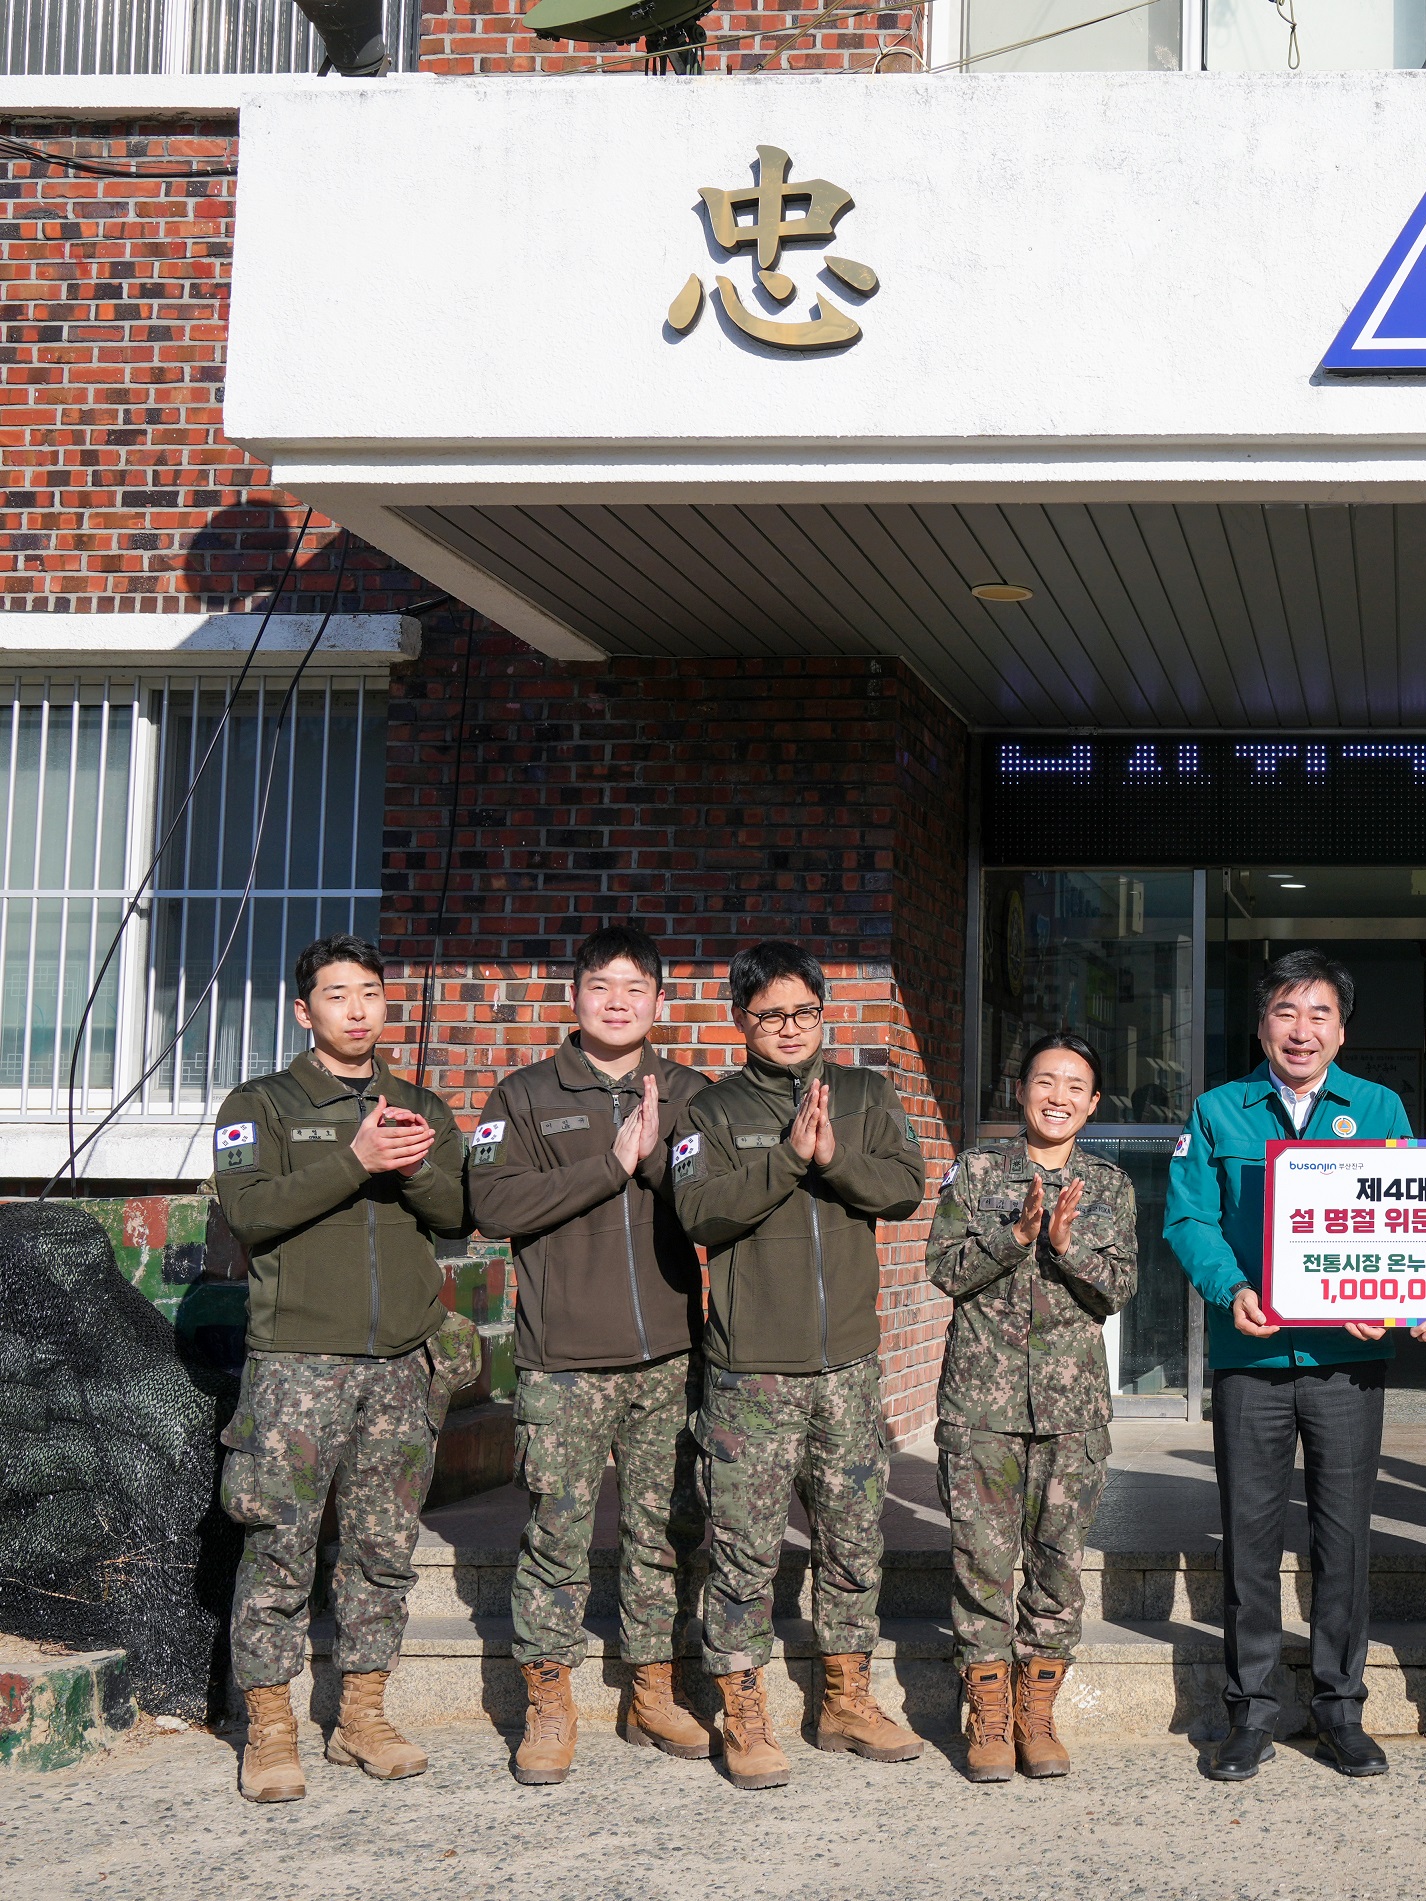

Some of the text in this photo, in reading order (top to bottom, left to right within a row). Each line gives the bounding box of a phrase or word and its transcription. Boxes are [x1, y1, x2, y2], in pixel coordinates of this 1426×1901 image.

[668, 144, 880, 351] 忠
[1290, 1161, 1364, 1172] busanjin 부산진구
[1289, 1208, 1314, 1234] 설
[1324, 1208, 1375, 1234] 명절
[1302, 1253, 1381, 1273] 전통시장
